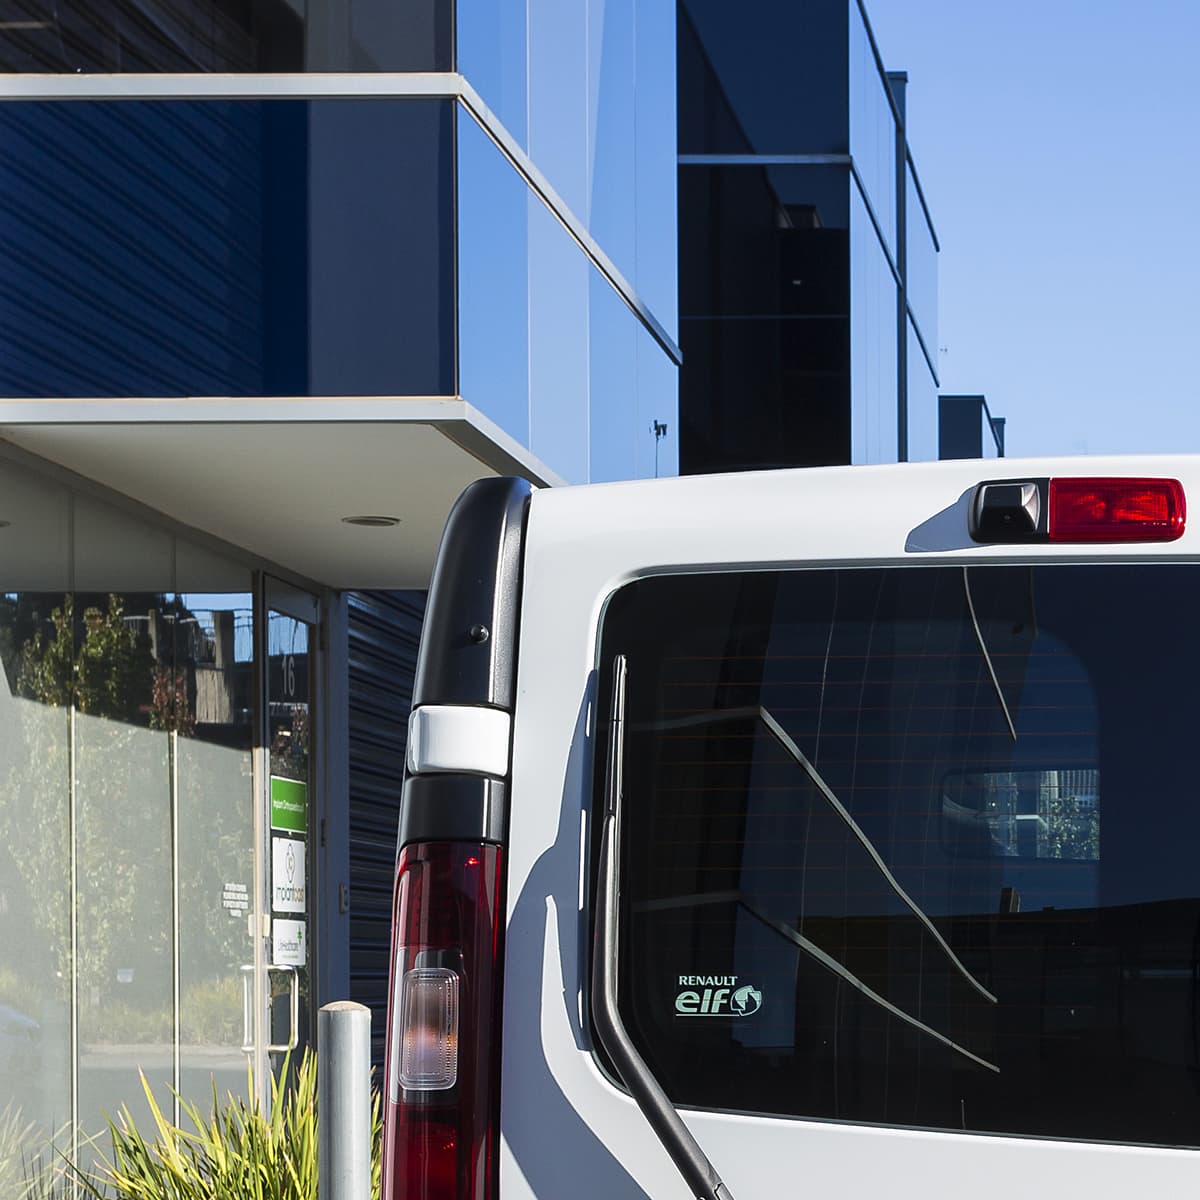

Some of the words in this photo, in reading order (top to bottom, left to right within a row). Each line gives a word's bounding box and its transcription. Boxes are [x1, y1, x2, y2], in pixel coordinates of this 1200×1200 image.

[281, 655, 296, 697] 16
[678, 975, 738, 986] RENAULT
[674, 988, 731, 1014] elf
